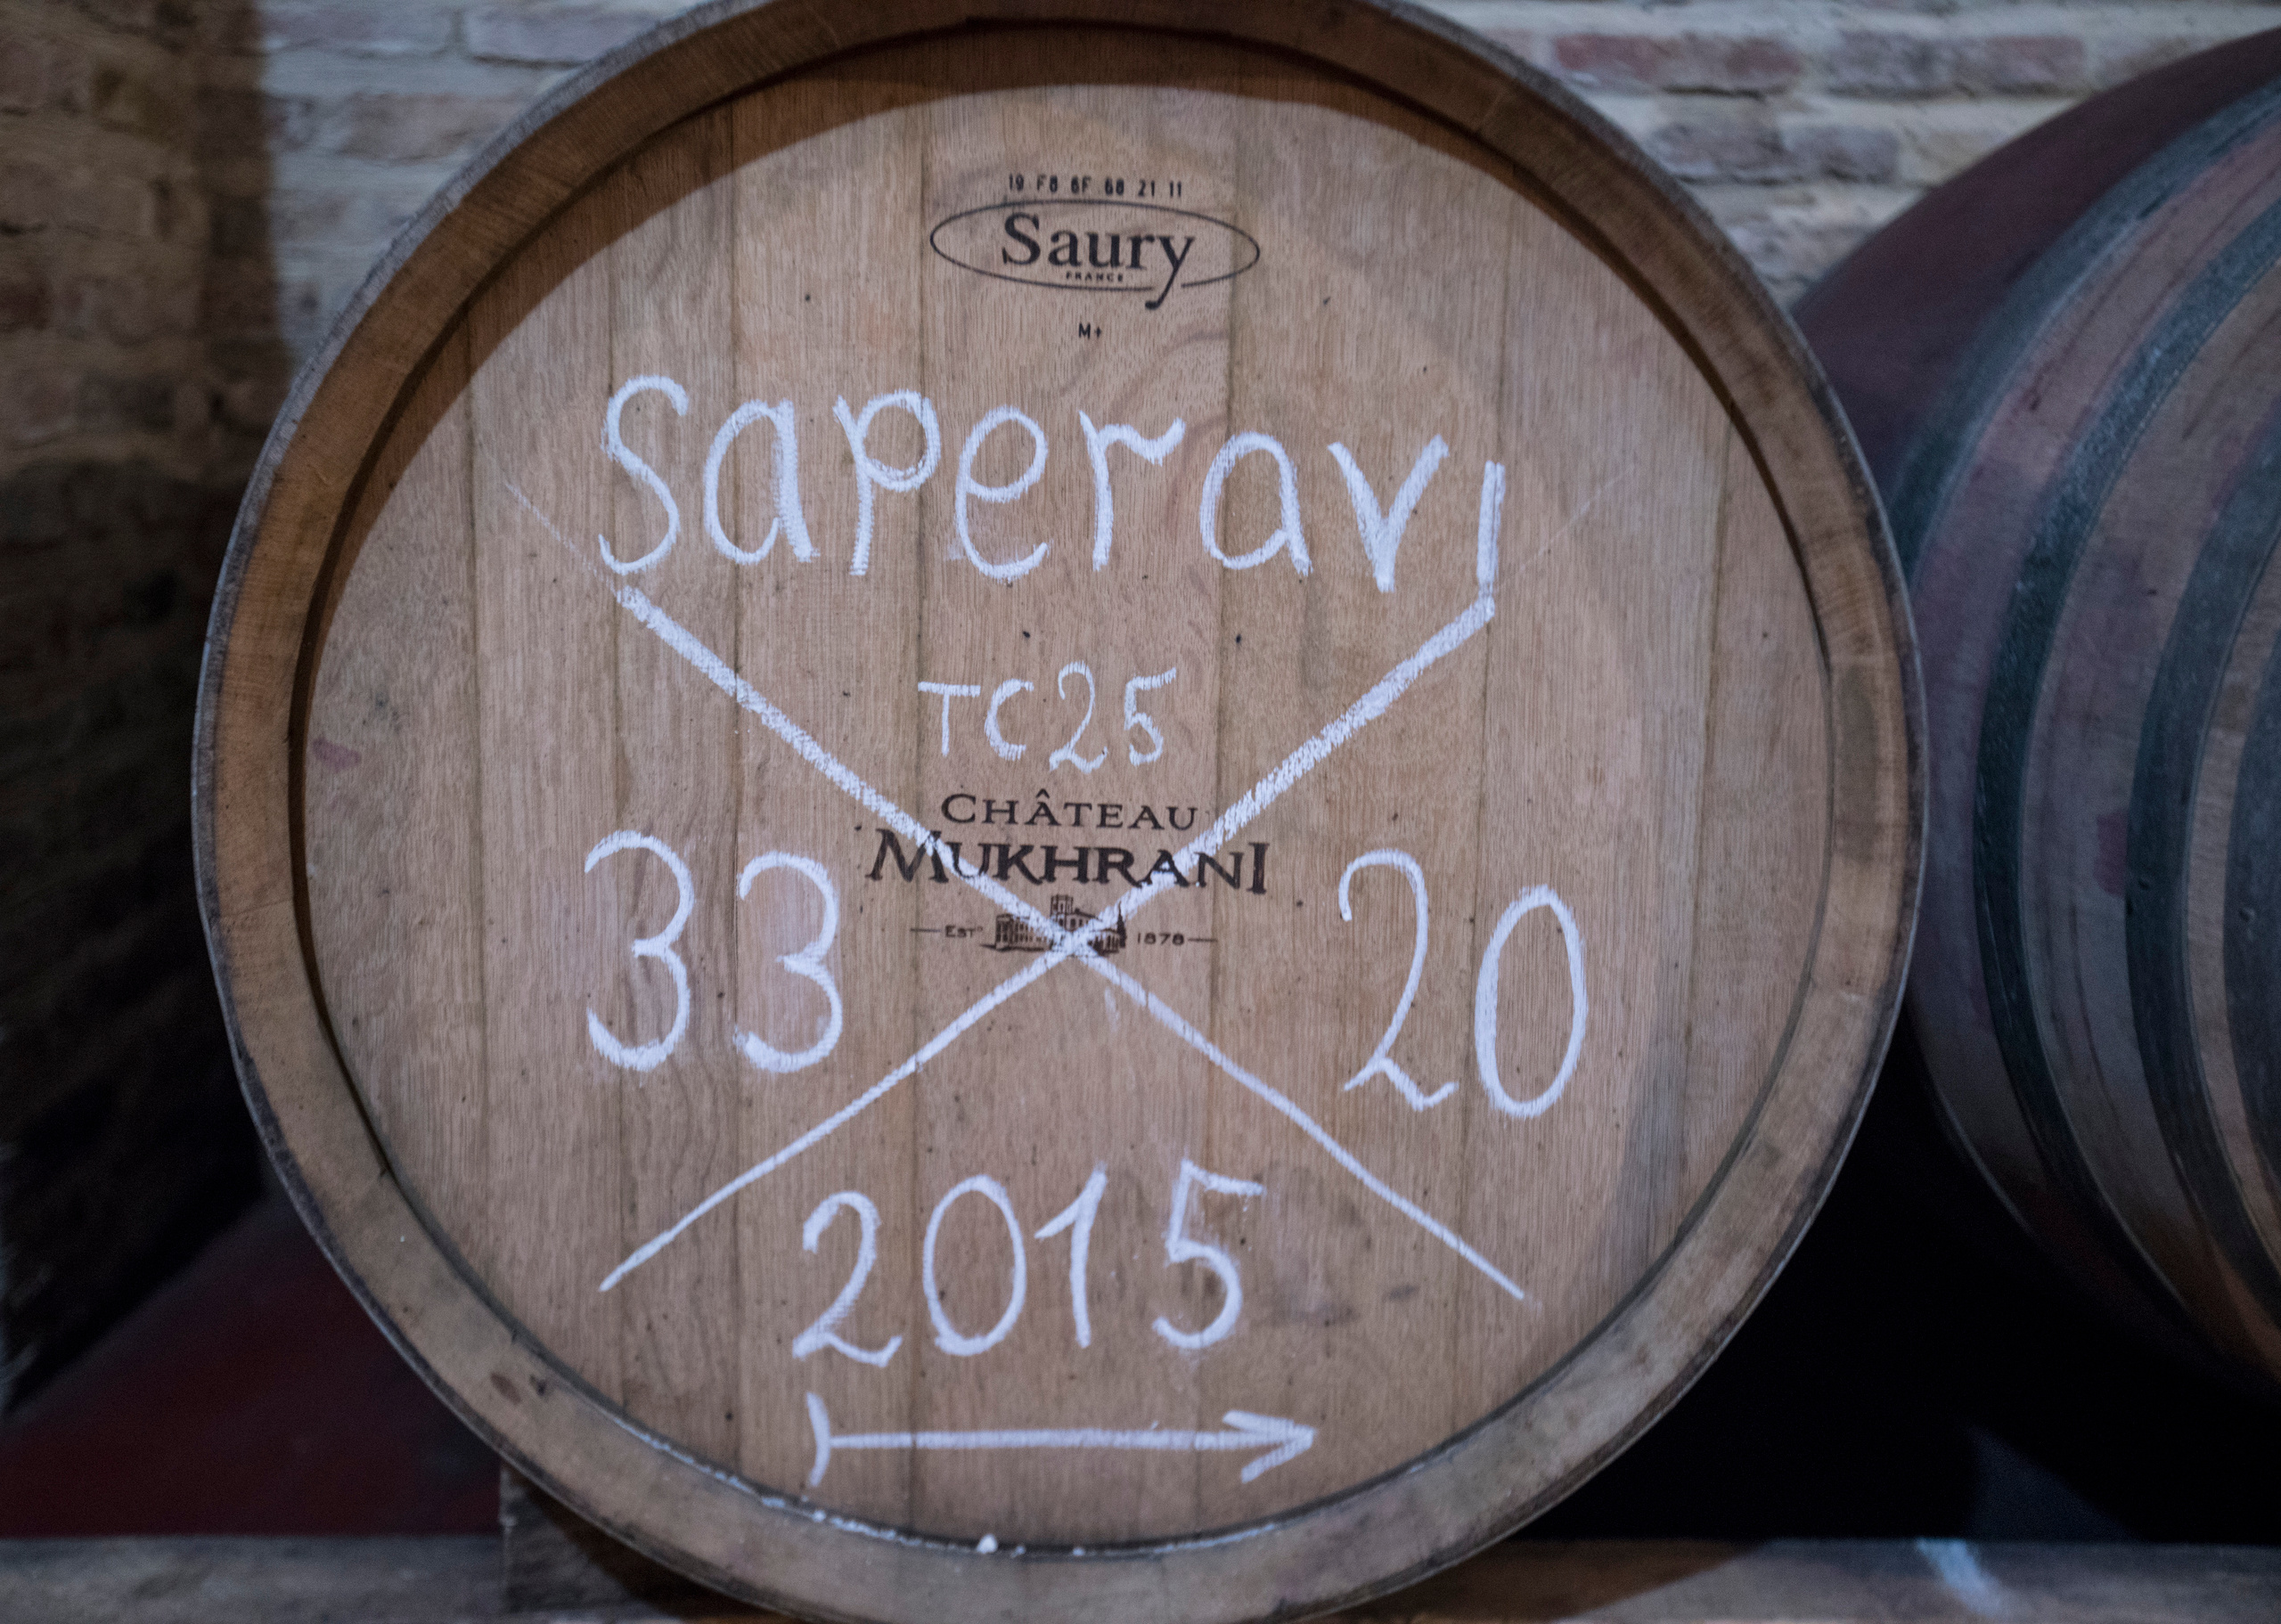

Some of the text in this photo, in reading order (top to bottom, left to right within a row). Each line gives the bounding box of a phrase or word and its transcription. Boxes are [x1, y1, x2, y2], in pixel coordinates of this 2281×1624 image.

[1138, 178, 1155, 197] 21
[1002, 212, 1196, 310] Saury
[1066, 271, 1124, 282] FRANCE
[1078, 322, 1102, 339] M+
[940, 788, 1198, 830] CHÂTEAU
[865, 828, 1270, 894] MUKHRANI
[585, 830, 843, 1074] 33
[1137, 933, 1185, 946] 1878
[1338, 848, 1587, 1119] 20
[792, 1158, 1265, 1367] 2015
